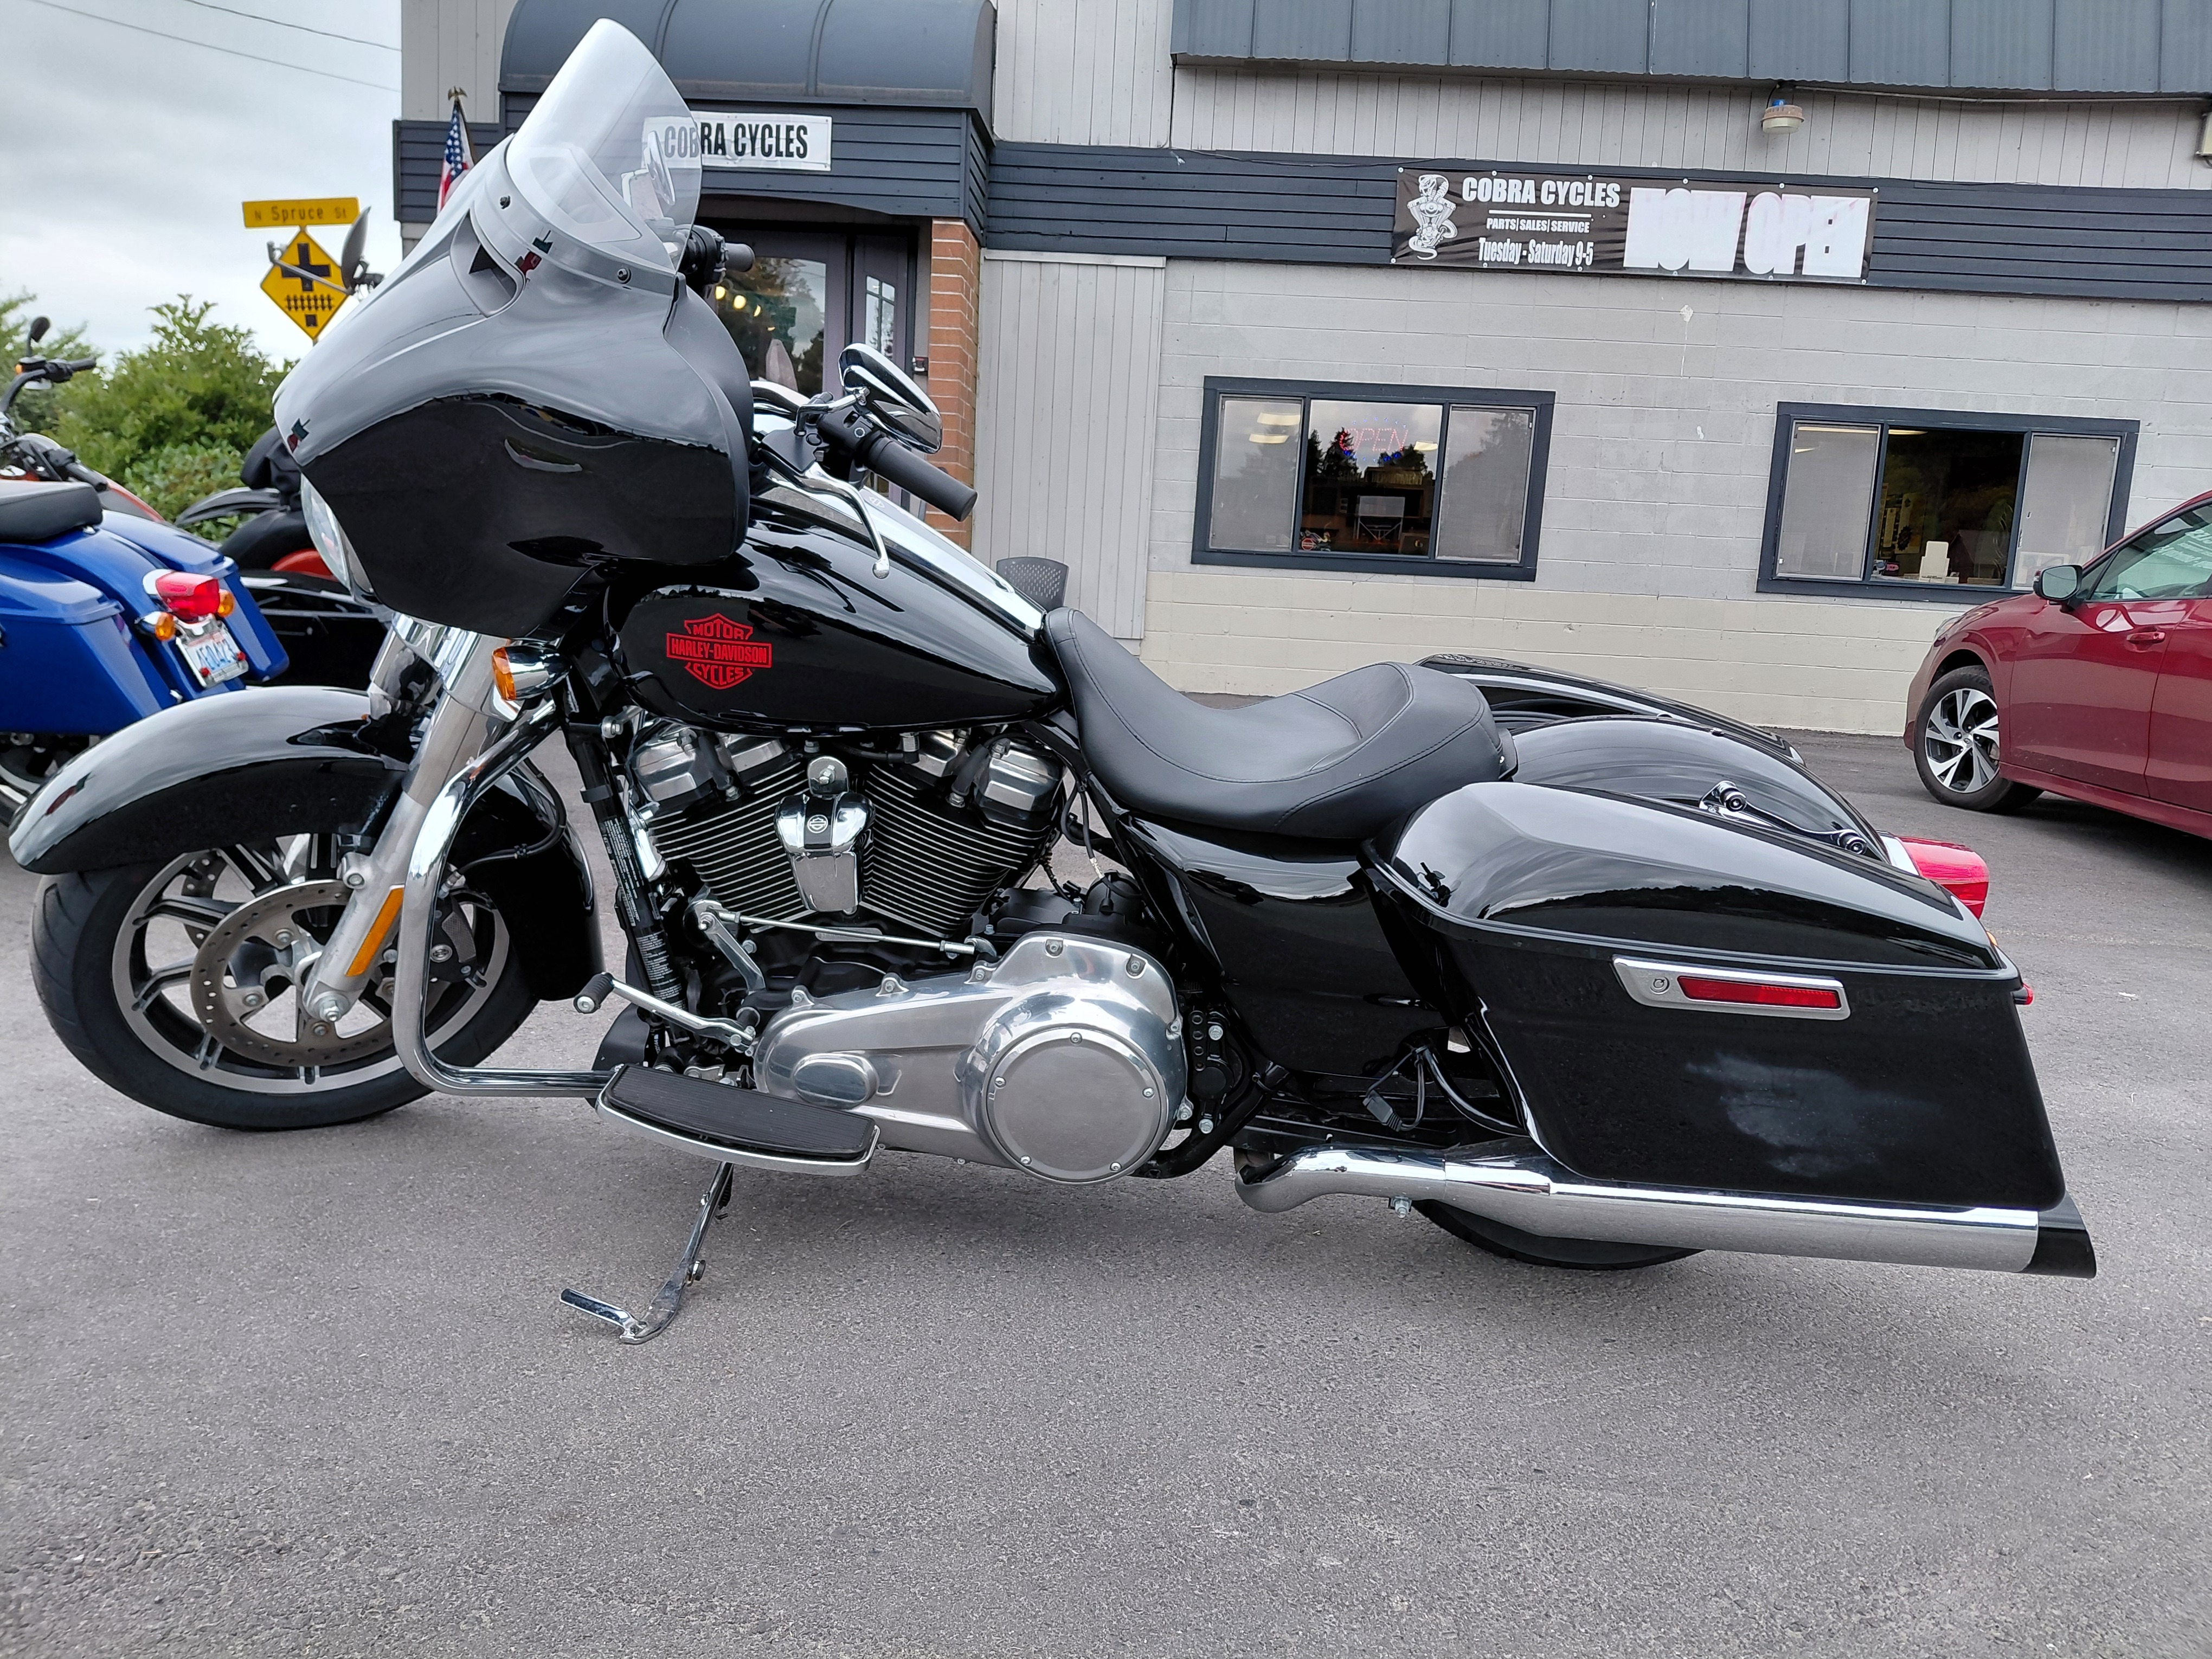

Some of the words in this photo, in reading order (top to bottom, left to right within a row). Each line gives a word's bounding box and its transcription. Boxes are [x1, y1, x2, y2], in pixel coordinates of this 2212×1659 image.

[665, 121, 726, 158] COBRA
[734, 123, 808, 158] CYCLES
[1462, 177, 1536, 204] COBRA
[1541, 180, 1621, 207] CYCLES
[254, 211, 262, 221] N
[271, 205, 324, 223] Spruce
[335, 207, 347, 218] St
[1478, 237, 1522, 265] Tuesday
[1528, 239, 1576, 267] Saturday
[1575, 241, 1594, 266] 9-5
[1339, 427, 1409, 452] OPEN
[693, 619, 744, 640] MOTOR
[671, 638, 767, 664] HARLEY-DAVIDSON
[693, 664, 744, 685] CYCLES
